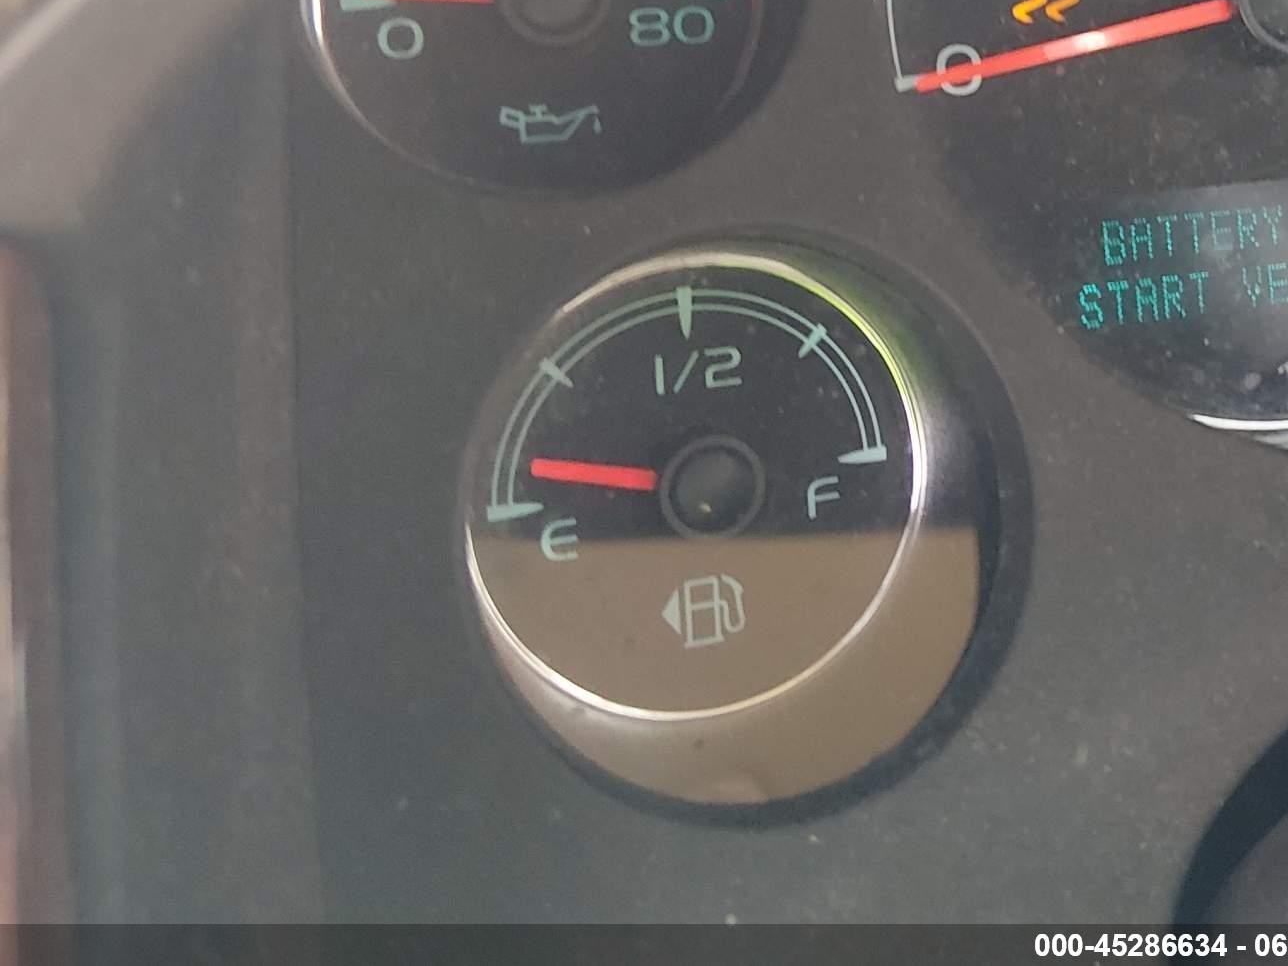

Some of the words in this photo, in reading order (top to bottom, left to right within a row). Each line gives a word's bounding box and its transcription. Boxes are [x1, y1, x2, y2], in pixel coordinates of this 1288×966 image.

[376, 16, 425, 59] 0
[628, 5, 715, 47] 80
[936, 43, 983, 96] 0
[1101, 204, 1284, 266] BATTERY
[1078, 270, 1210, 331] START
[653, 345, 743, 396] 1/2
[806, 475, 841, 520] F
[539, 518, 580, 563] E
